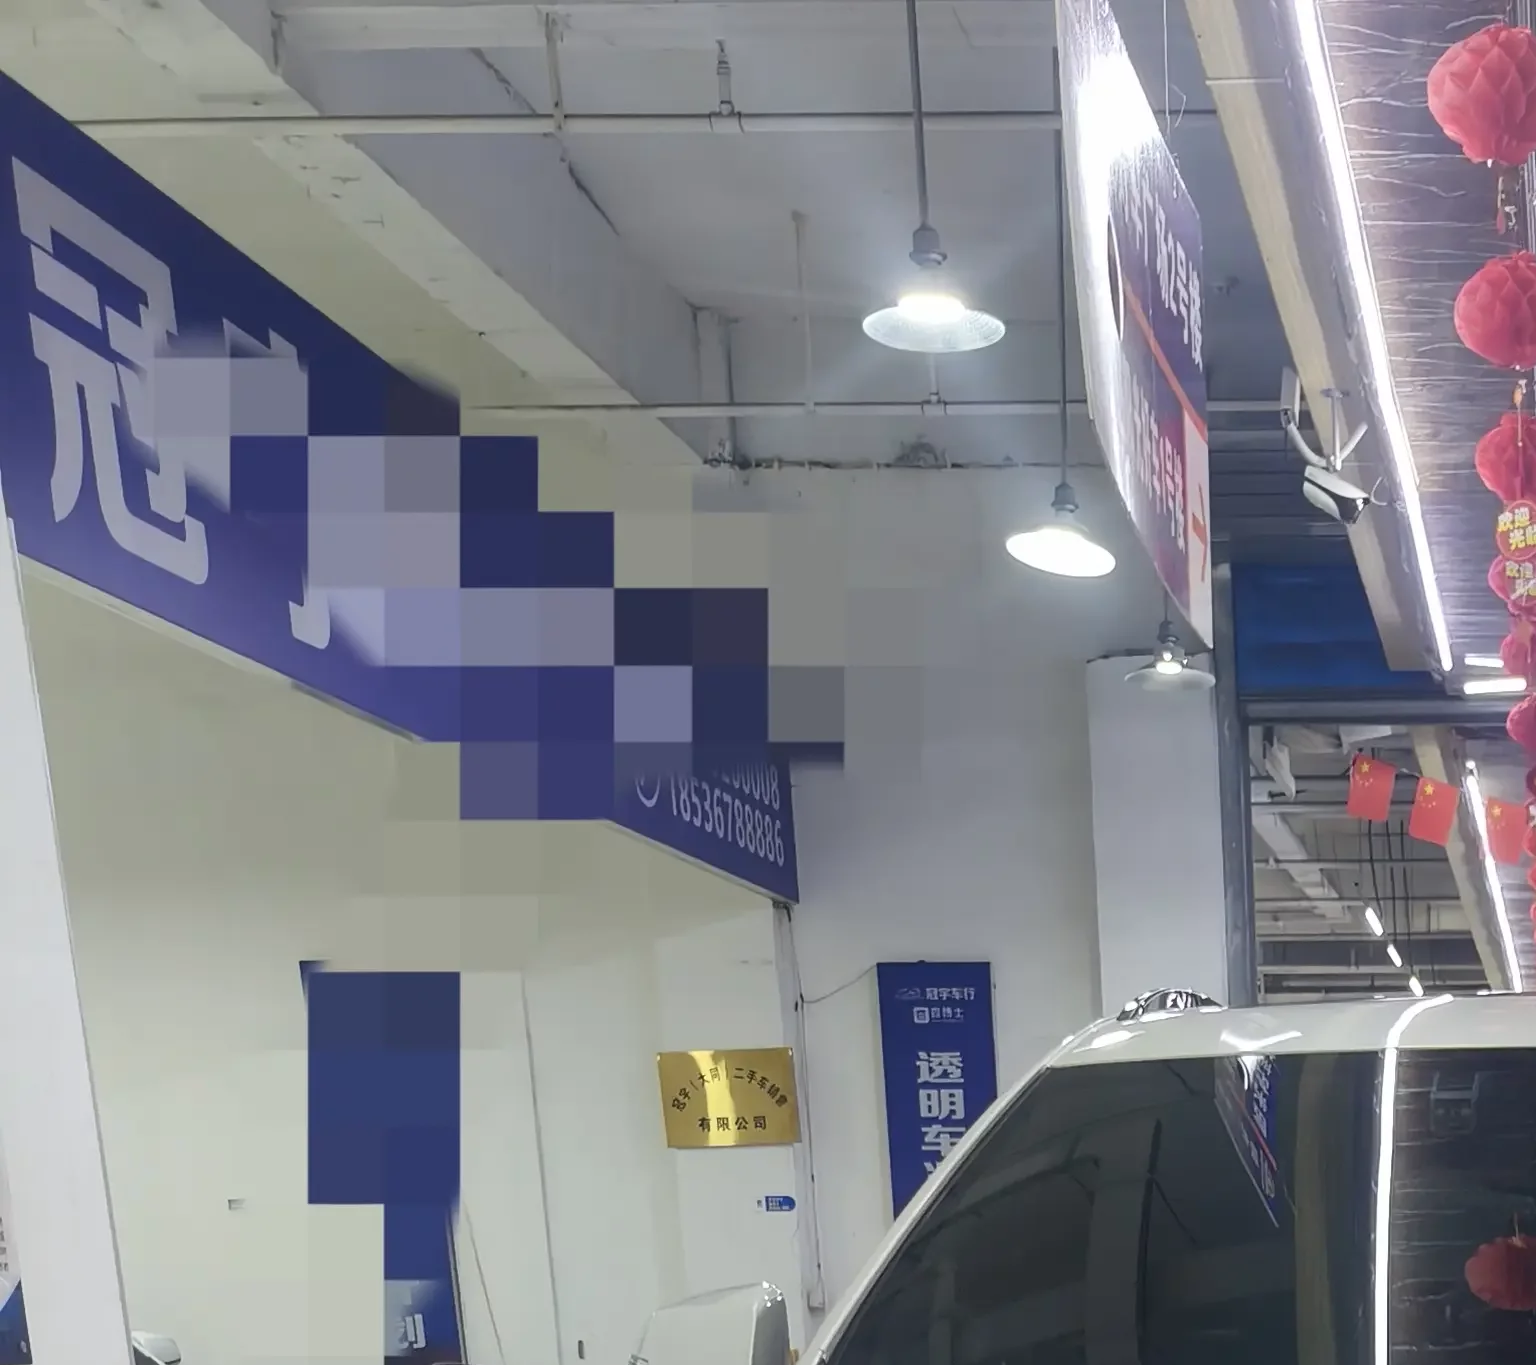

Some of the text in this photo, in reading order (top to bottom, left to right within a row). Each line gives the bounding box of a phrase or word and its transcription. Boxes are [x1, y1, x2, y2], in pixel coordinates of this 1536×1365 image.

[698, 1115, 767, 1132] 有限公司
[915, 1051, 967, 1174] 透明车
